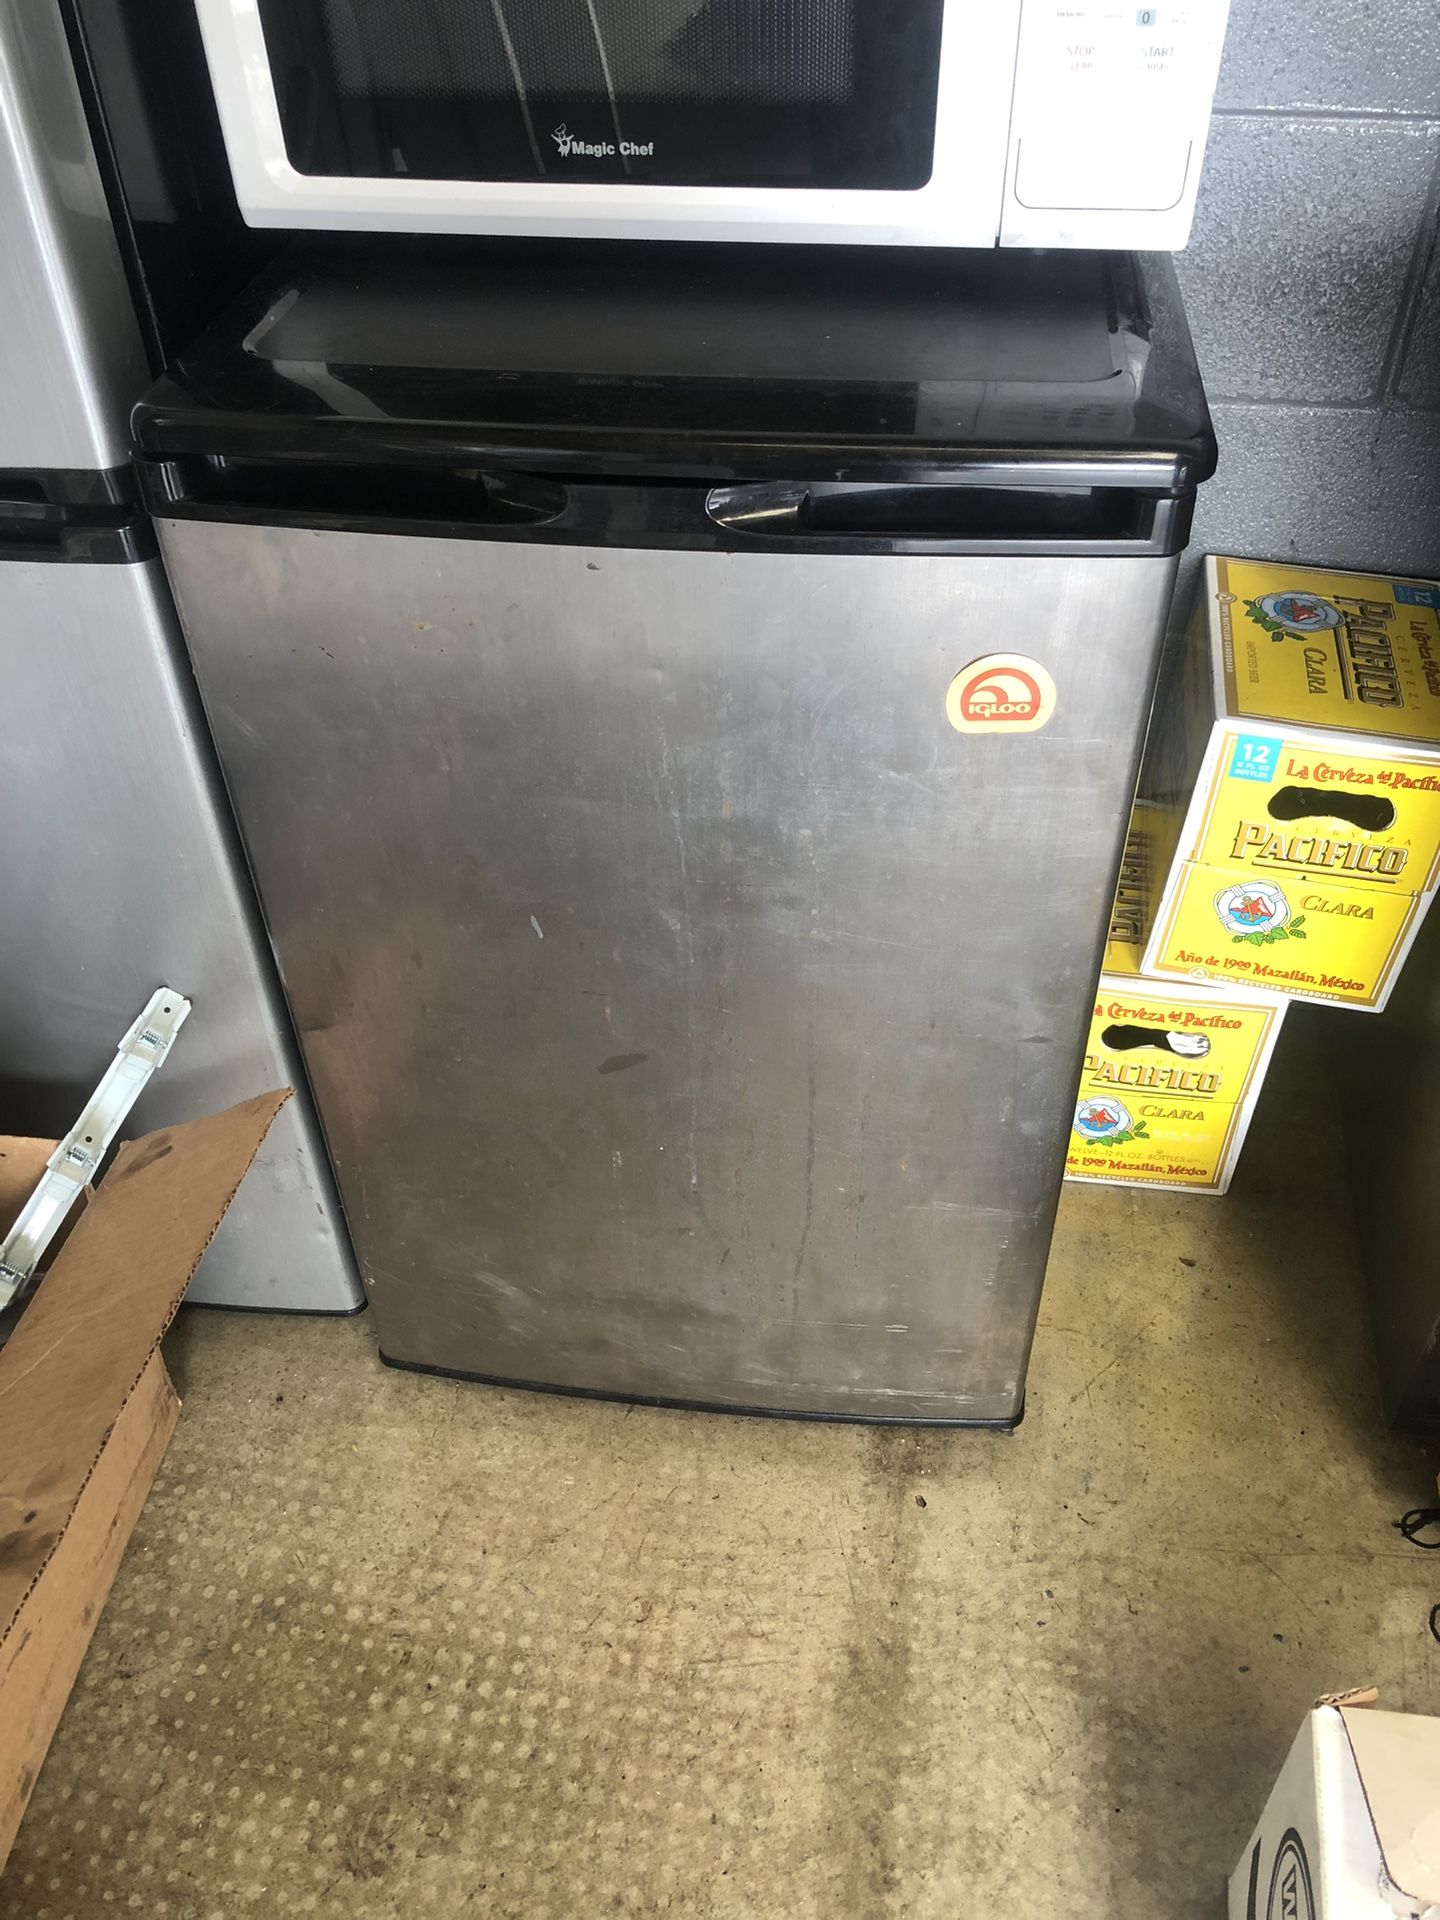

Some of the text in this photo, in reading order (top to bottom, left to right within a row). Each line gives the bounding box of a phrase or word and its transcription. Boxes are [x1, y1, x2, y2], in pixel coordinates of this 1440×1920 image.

[1066, 44, 1096, 57] STOP
[1141, 46, 1174, 57] START
[572, 141, 654, 157] Magic Chef
[1225, 640, 1234, 673] CARDBOARD
[1333, 595, 1404, 708] PACIFICO
[1303, 647, 1328, 695] CLARA
[1395, 635, 1421, 711] CERVEZA
[968, 703, 1031, 718] IGLOO
[1242, 743, 1271, 764] 12
[1234, 768, 1269, 779] BOTTLES
[1286, 759, 1309, 780] La
[1313, 762, 1374, 785] Cerveza
[1230, 820, 1409, 875] PACIFICO
[1301, 895, 1375, 920] CLARA
[1175, 950, 1202, 963] Año
[1205, 956, 1220, 967] de
[1222, 957, 1251, 972] 1900
[1317, 973, 1365, 991] México
[1238, 977, 1282, 992] RECYCLED
[1284, 986, 1340, 1000] CARDBOARD
[1093, 1004, 1103, 1017] a
[1107, 1002, 1165, 1022] Cerveza
[1138, 1104, 1205, 1121] CLARA
[1147, 1153, 1186, 1162] BOTTLES
[1137, 1177, 1187, 1186] CARDBOARD
